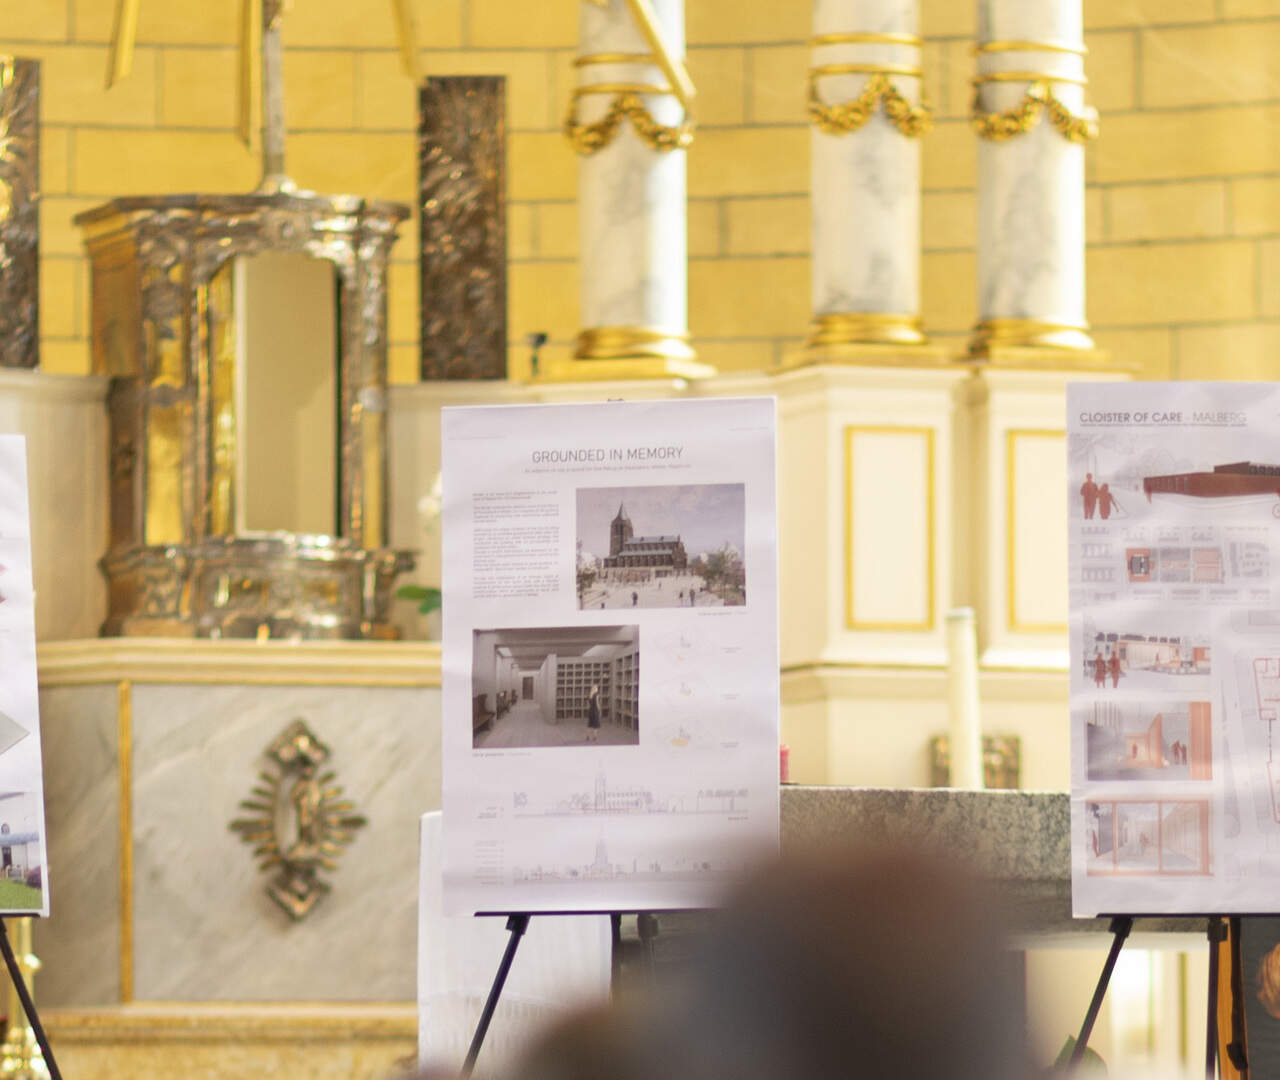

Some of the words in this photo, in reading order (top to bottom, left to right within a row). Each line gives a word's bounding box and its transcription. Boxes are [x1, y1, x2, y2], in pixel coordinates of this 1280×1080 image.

[1079, 412, 1130, 423] CLOISTER
[1133, 412, 1148, 423] OF
[1152, 412, 1183, 423] CARE
[1193, 412, 1247, 423] MALBERG
[532, 449, 605, 463] GROUNDED
[609, 449, 622, 461] IN
[627, 446, 684, 460] MEMORY
